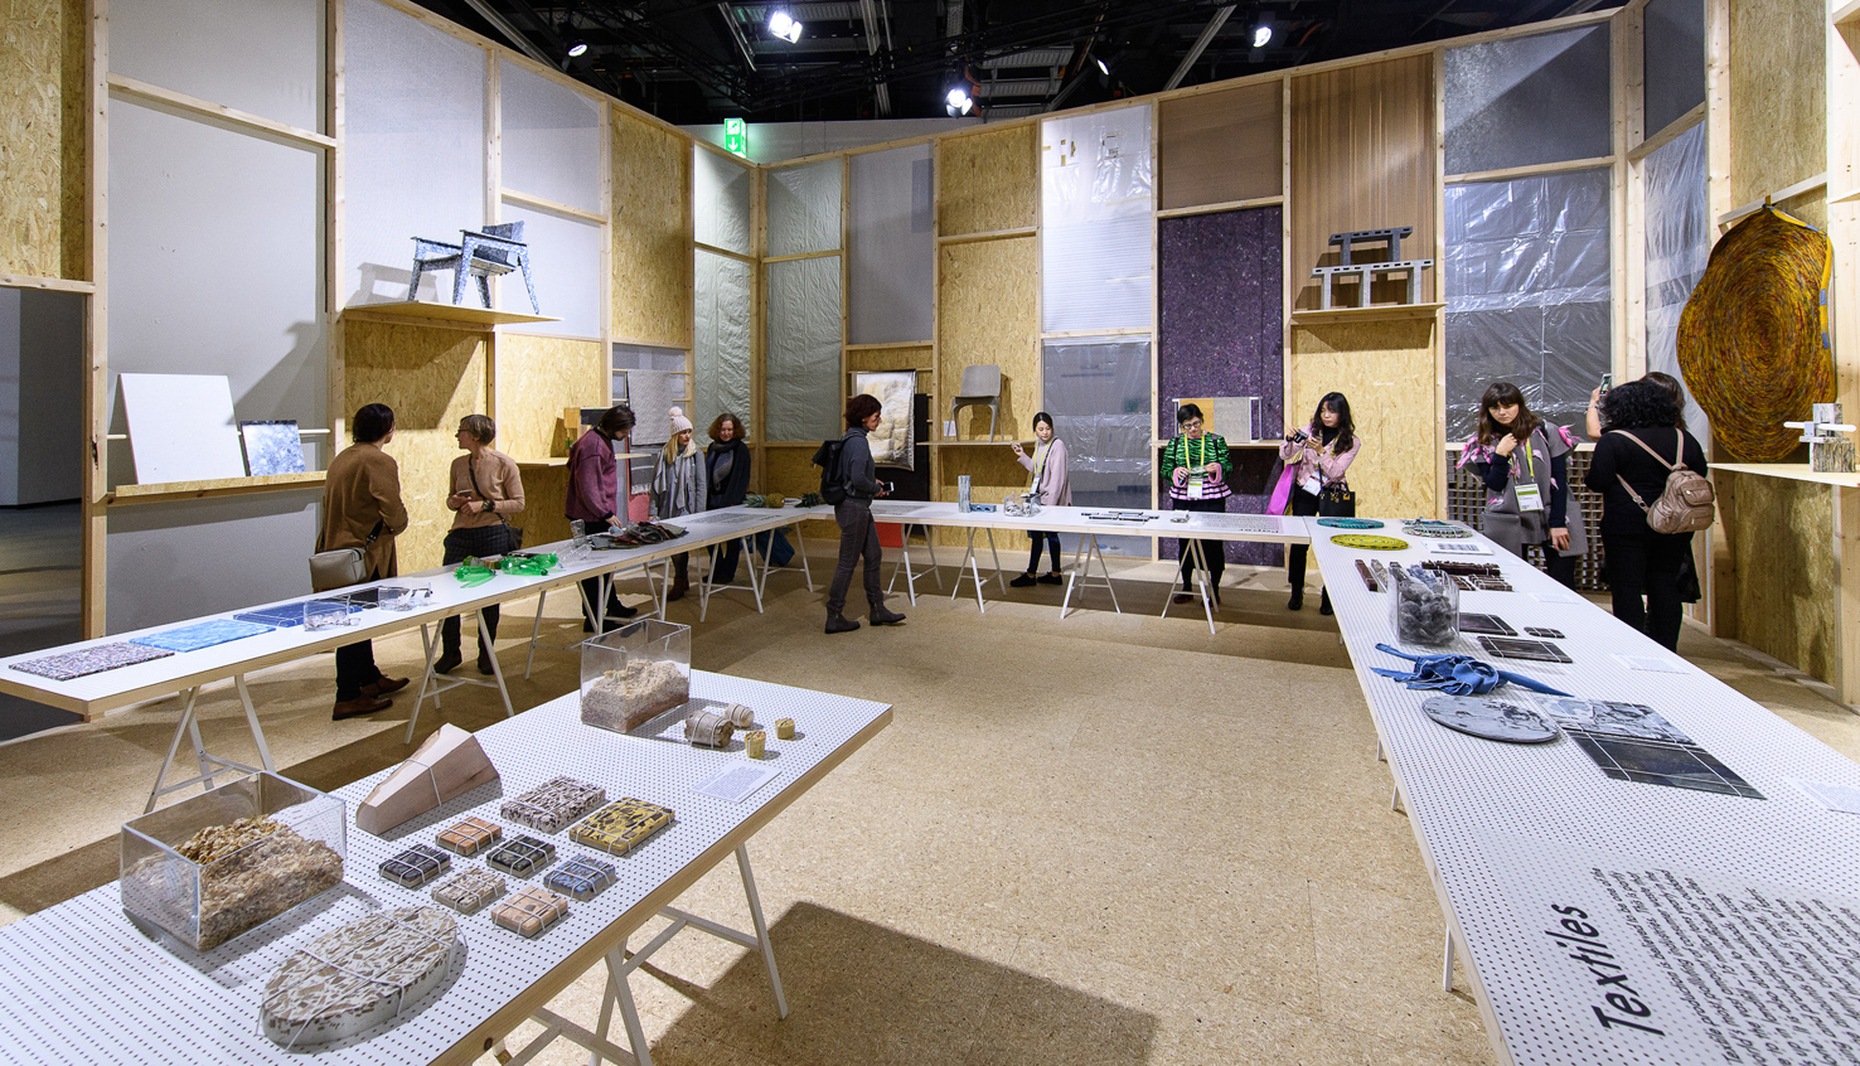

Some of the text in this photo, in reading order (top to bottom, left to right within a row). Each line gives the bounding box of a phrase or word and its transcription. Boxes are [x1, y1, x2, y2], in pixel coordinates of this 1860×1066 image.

[1626, 923, 1665, 960] believed
[1544, 904, 1665, 1036] Textiles
[1675, 958, 1721, 1001] polluting
[1739, 962, 1770, 989] down
[1757, 960, 1819, 1014] production
[1666, 971, 1719, 1026] production
[1707, 1001, 1738, 1027] most
[1801, 1014, 1836, 1038] and
[1705, 1027, 1743, 1063] Textile
